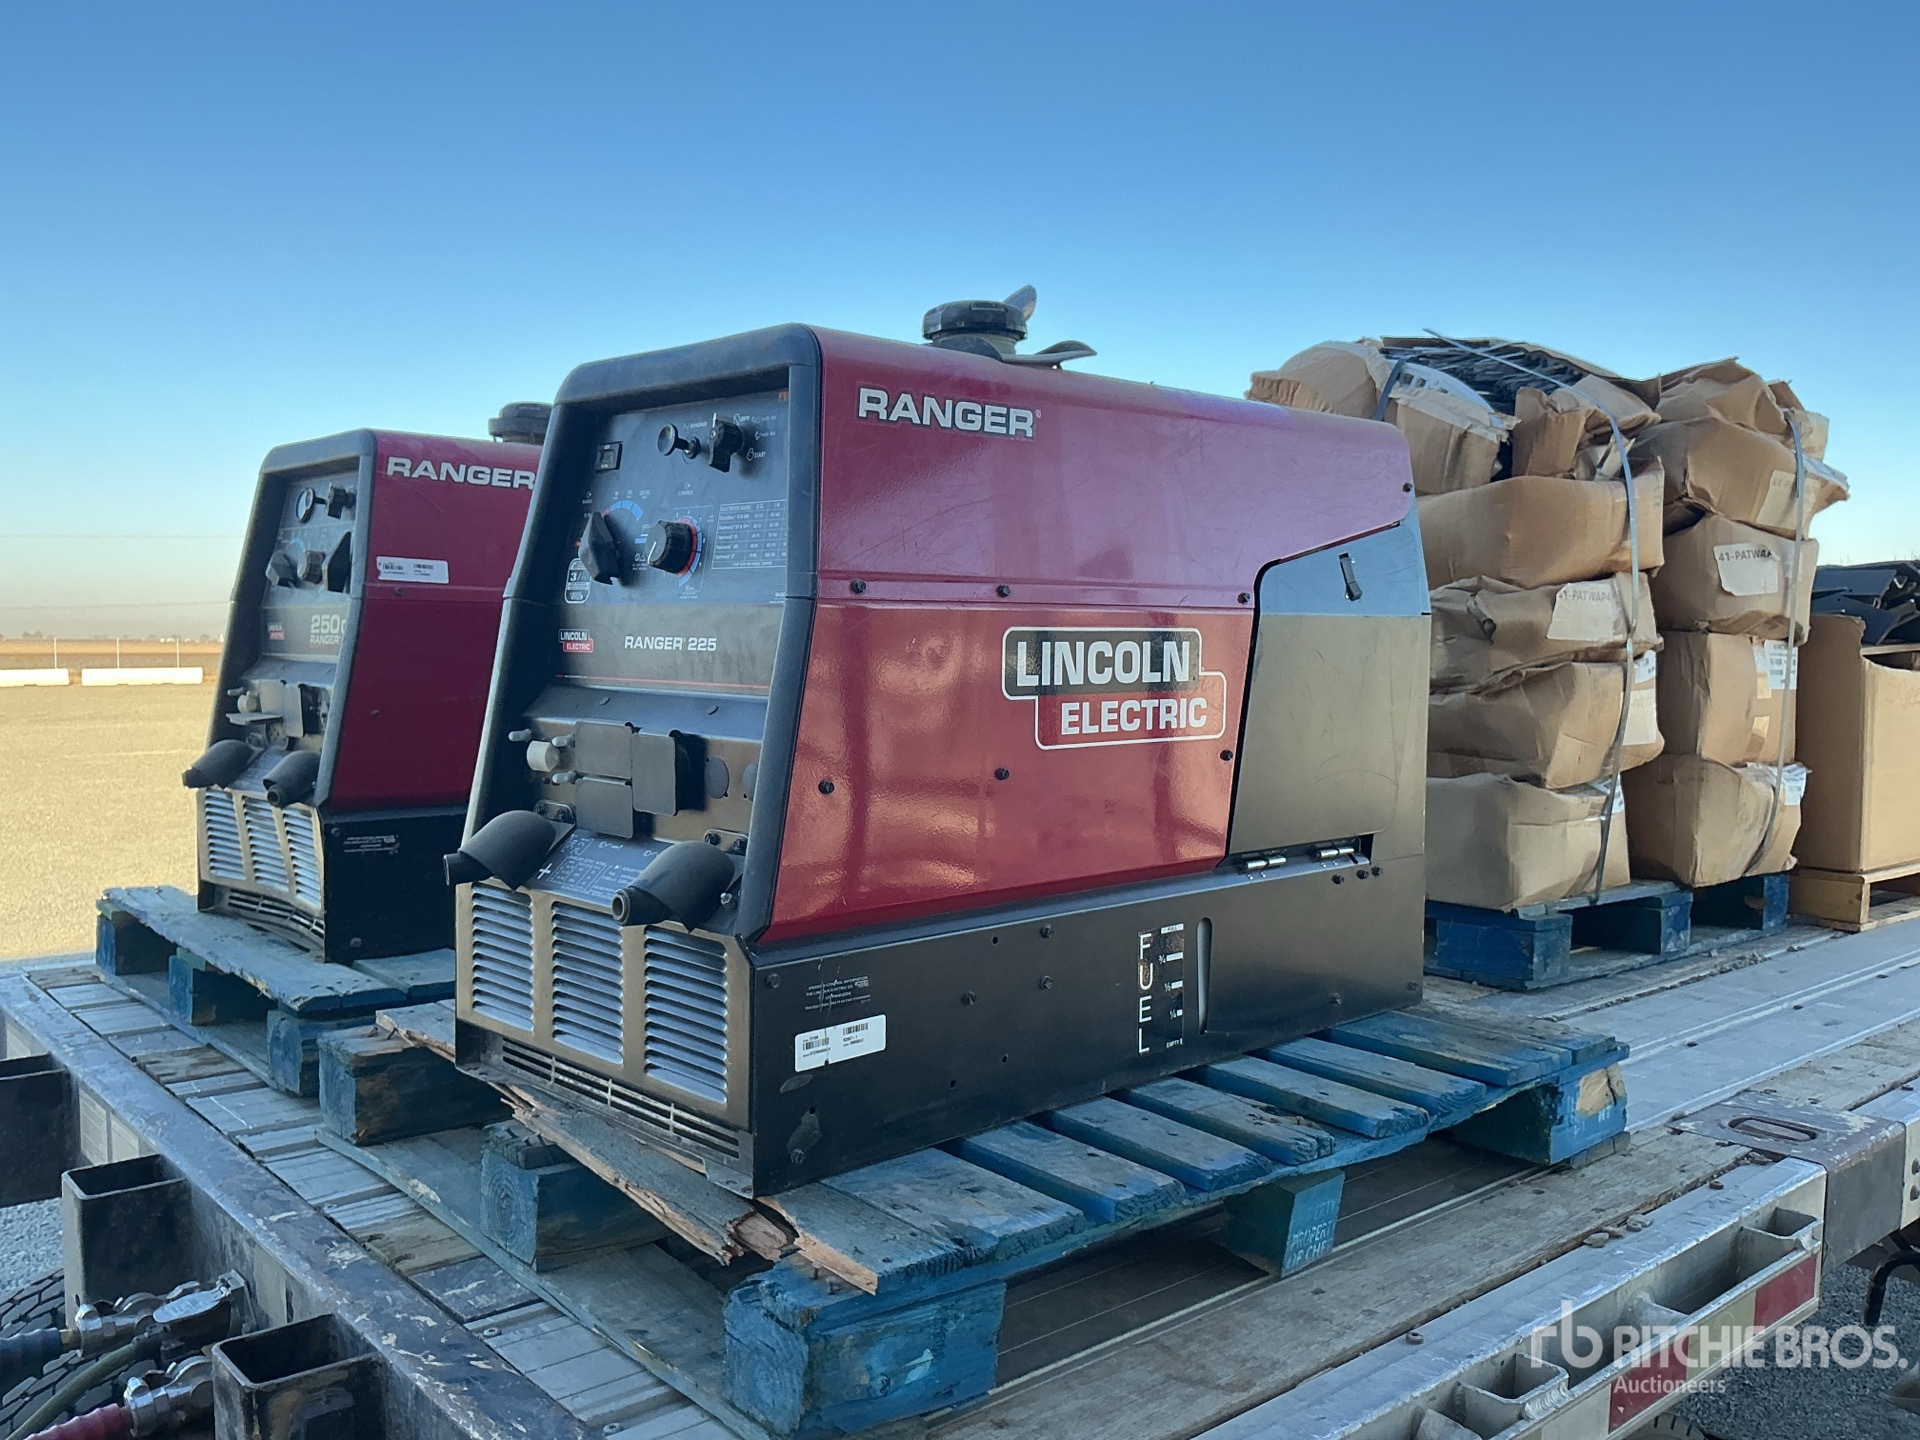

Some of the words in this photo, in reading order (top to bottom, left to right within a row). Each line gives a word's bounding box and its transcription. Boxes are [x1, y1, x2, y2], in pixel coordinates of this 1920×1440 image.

[858, 388, 1034, 438] RANGER
[386, 456, 536, 490] RANGER
[309, 634, 339, 646] RANGER
[560, 631, 588, 641] LINCOLN
[566, 642, 591, 651] ELECTRIC
[624, 635, 683, 650] RANGER
[687, 637, 717, 652] 225
[1016, 640, 1190, 687] LINCOLN
[1060, 697, 1208, 736] ELECTRIC
